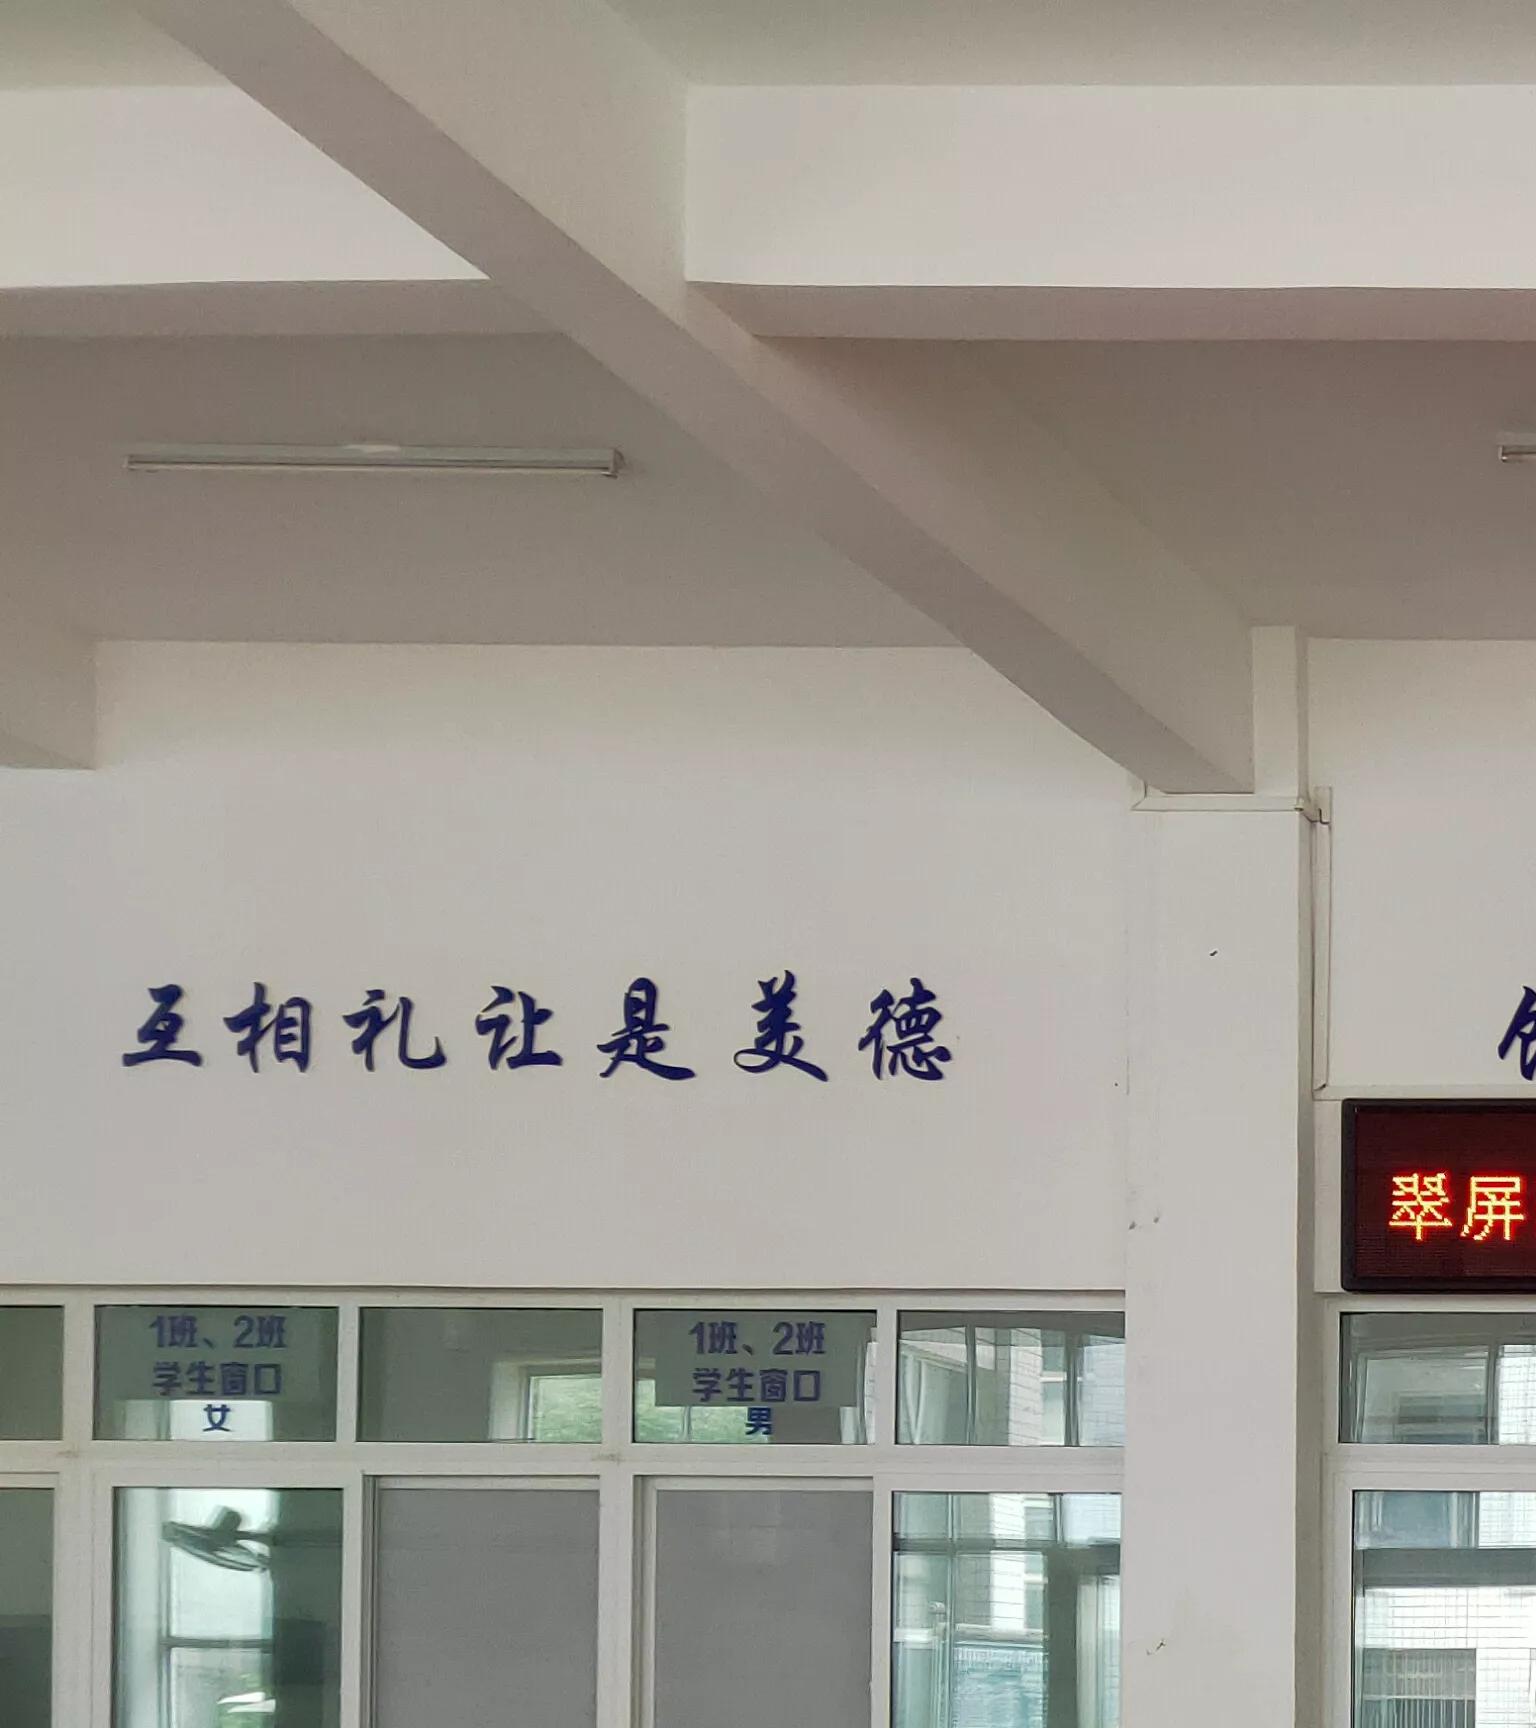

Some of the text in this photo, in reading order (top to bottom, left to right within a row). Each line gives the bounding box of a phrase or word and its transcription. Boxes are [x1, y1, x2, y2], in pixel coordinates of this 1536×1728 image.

[122, 969, 952, 1082] 互相礼让是美德
[688, 1321, 826, 1355] 1班、2班
[152, 1361, 282, 1396] 学生窗口
[692, 1368, 821, 1402] 学生窗口
[203, 1404, 231, 1432] 女
[745, 1407, 772, 1435] 男
